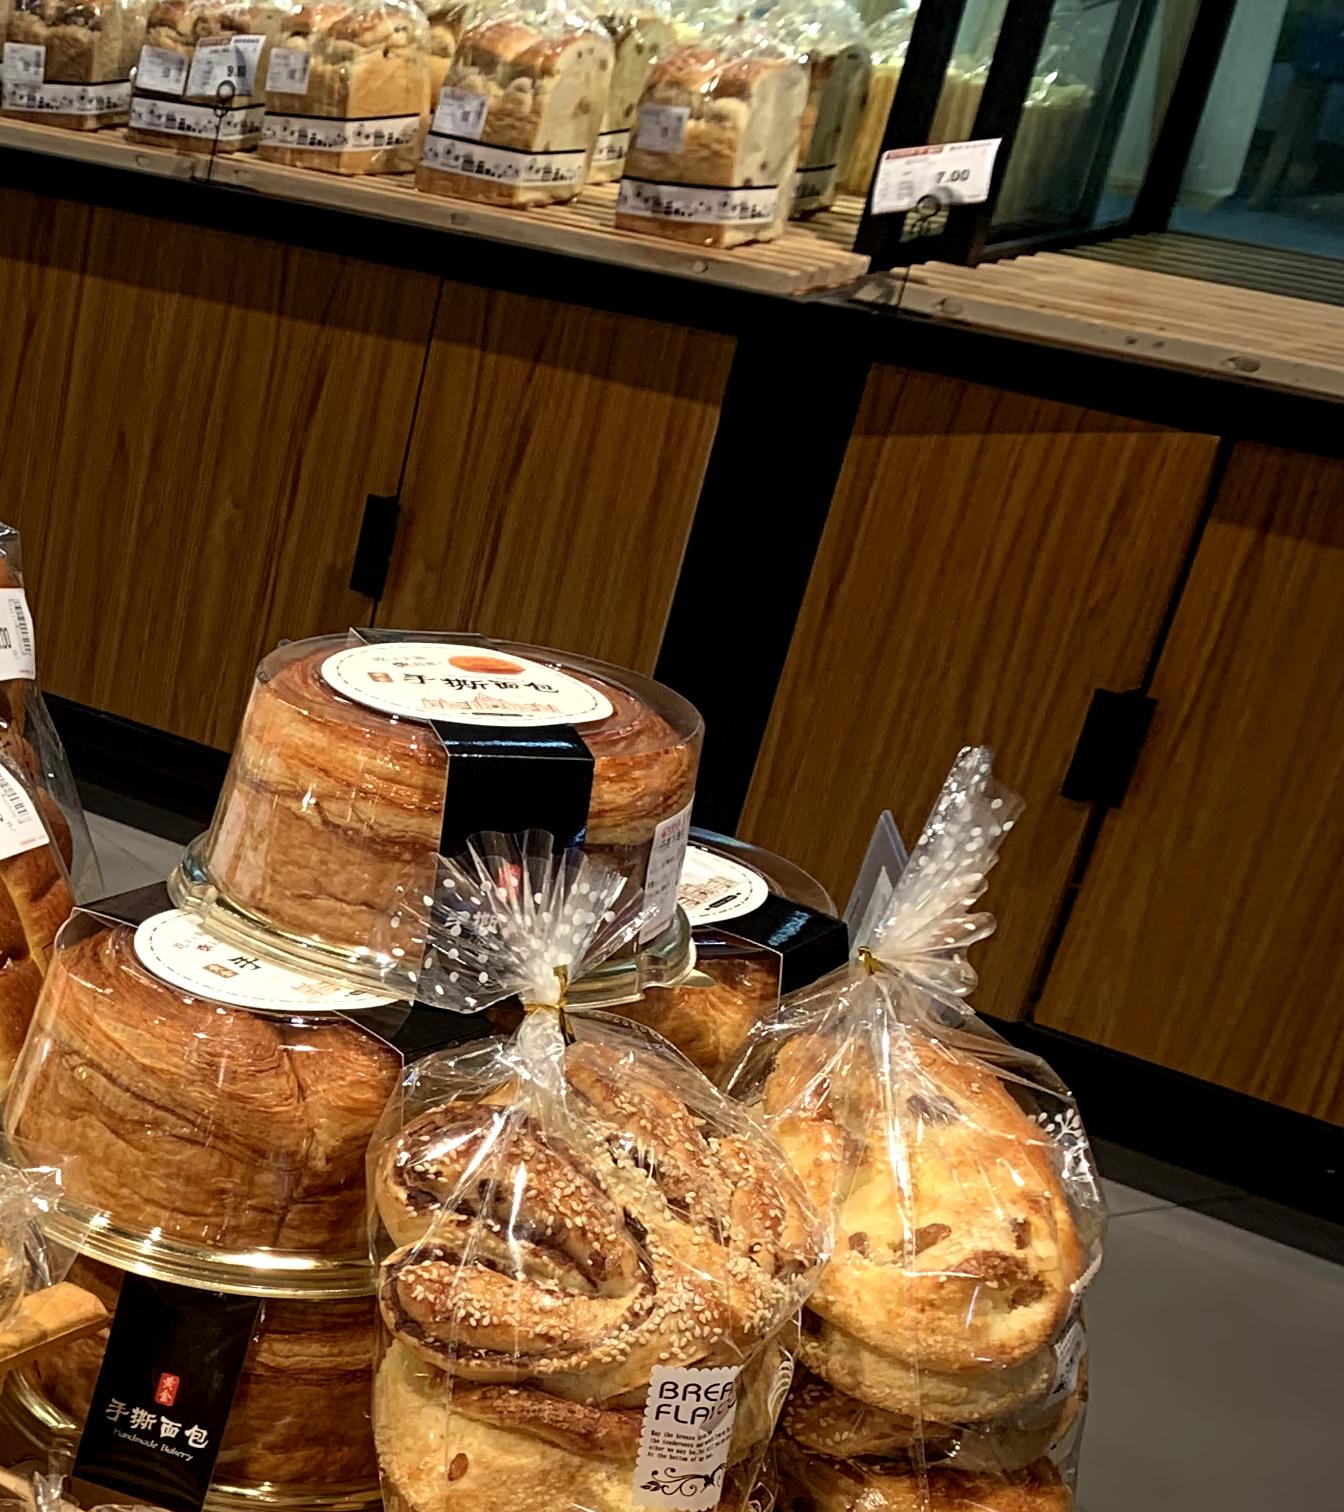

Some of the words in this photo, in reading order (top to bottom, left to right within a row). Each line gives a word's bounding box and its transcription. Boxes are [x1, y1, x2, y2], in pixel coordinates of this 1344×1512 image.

[658, 1380, 736, 1402] BREA
[105, 1398, 209, 1449] 手撕面包
